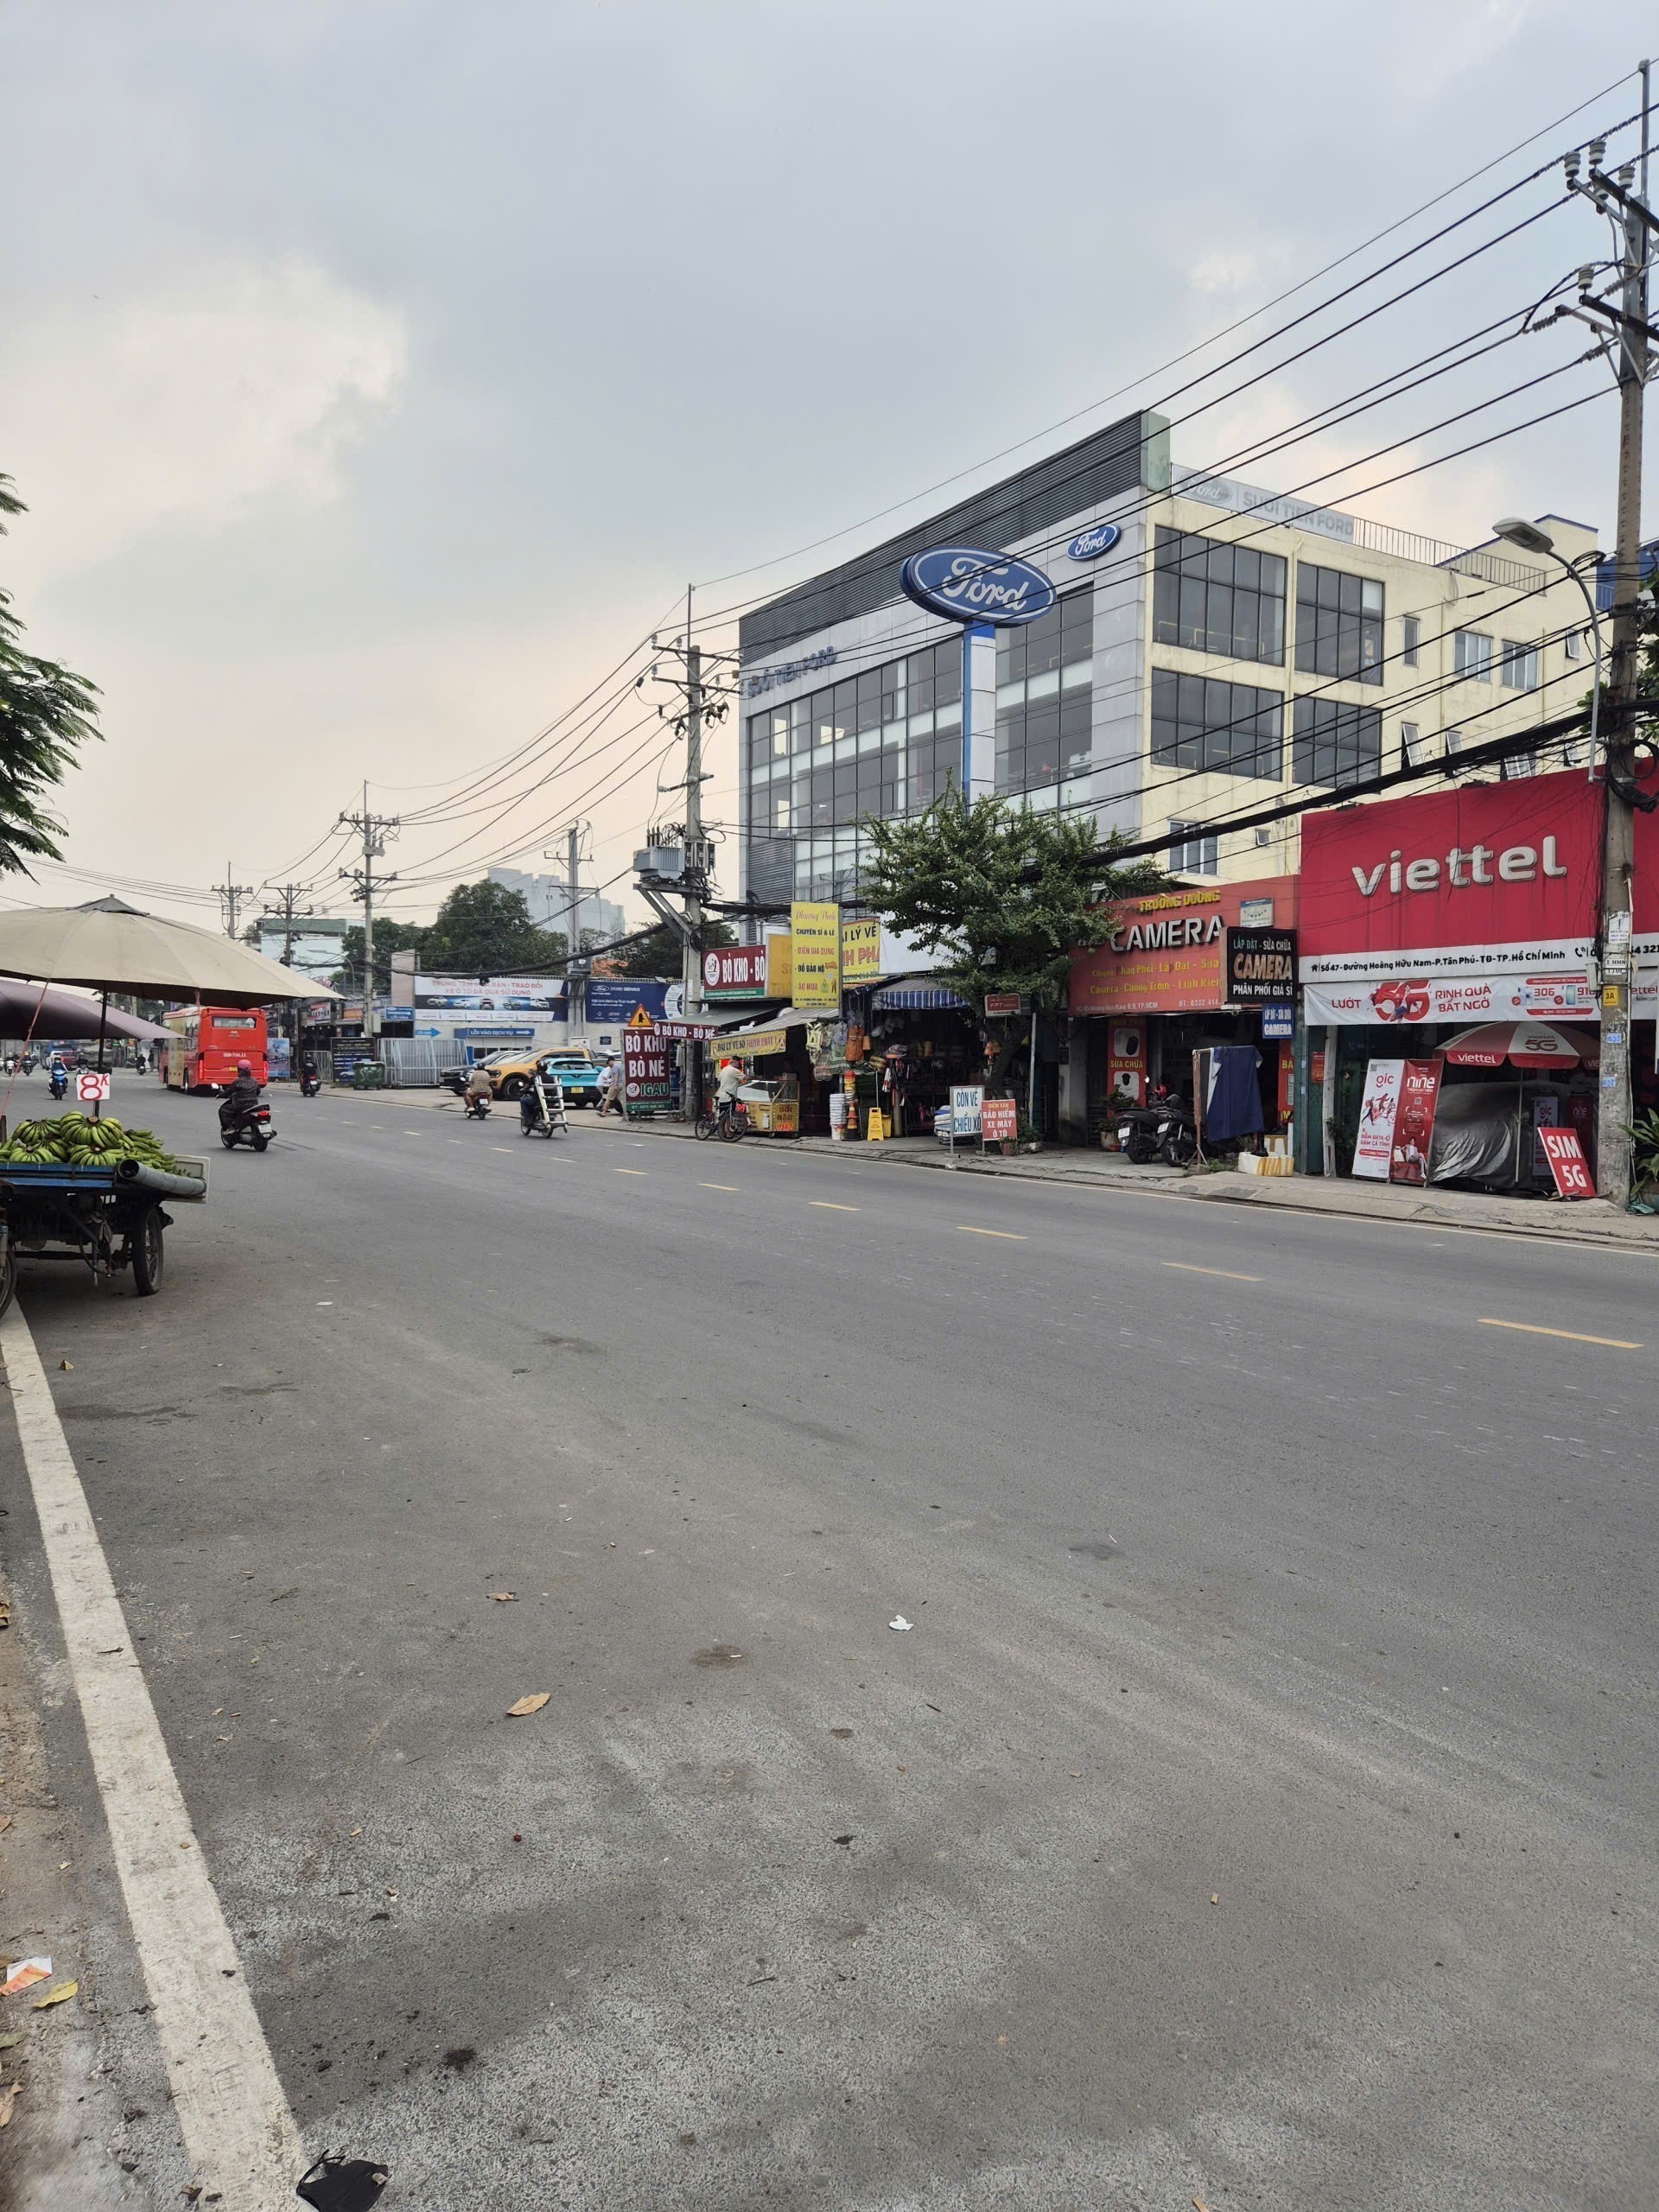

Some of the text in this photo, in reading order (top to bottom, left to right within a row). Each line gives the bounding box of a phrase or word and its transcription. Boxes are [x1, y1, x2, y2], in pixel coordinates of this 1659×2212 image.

[1317, 513, 1353, 536] FORD
[1074, 528, 1108, 556] Ford
[942, 556, 1030, 611] Ford
[1352, 835, 1567, 896] viettel
[850, 925, 861, 941] LÝ
[1110, 915, 1223, 952] CAMERA
[1233, 937, 1245, 950] LẮP
[1262, 936, 1275, 951] SỬA
[1275, 938, 1292, 951] CHỮA
[722, 949, 766, 983] BÒ KHO BÒ
[1233, 952, 1293, 981] CAMERA
[1370, 961, 1394, 971] Hoàng
[1395, 959, 1412, 968] Hữu
[1525, 949, 1541, 961] Chí
[1541, 950, 1566, 960] Minh
[1233, 982, 1252, 995] PHÂN
[1254, 982, 1271, 995] PHỐI
[1273, 983, 1284, 995] GIÁ
[1435, 983, 1491, 1000] RINH QUÀ
[1534, 988, 1555, 996] 306
[1332, 998, 1362, 1009] LƯỚT
[1438, 996, 1491, 1013] BẤT NGỜ
[662, 1023, 671, 1036] BÒ
[672, 1026, 687, 1037] KHO
[693, 1025, 704, 1039] BÒ
[625, 1031, 666, 1053] BÒ KHO
[1524, 1039, 1558, 1052] 5G
[628, 1055, 665, 1077] BÒ NÉ
[1457, 1052, 1497, 1065] viettel
[1376, 1073, 1395, 1089] gic
[1407, 1076, 1435, 1089] nine
[957, 1088, 978, 1108] CÒN VÉ
[983, 1108, 1016, 1119] BẢO HIỂM
[953, 1114, 972, 1134] CHIỀU
[987, 1120, 1012, 1129] XE MÁY
[999, 1129, 1008, 1138] TÔ
[1547, 1135, 1583, 1160] SIM
[1560, 1165, 1588, 1188] 5G
